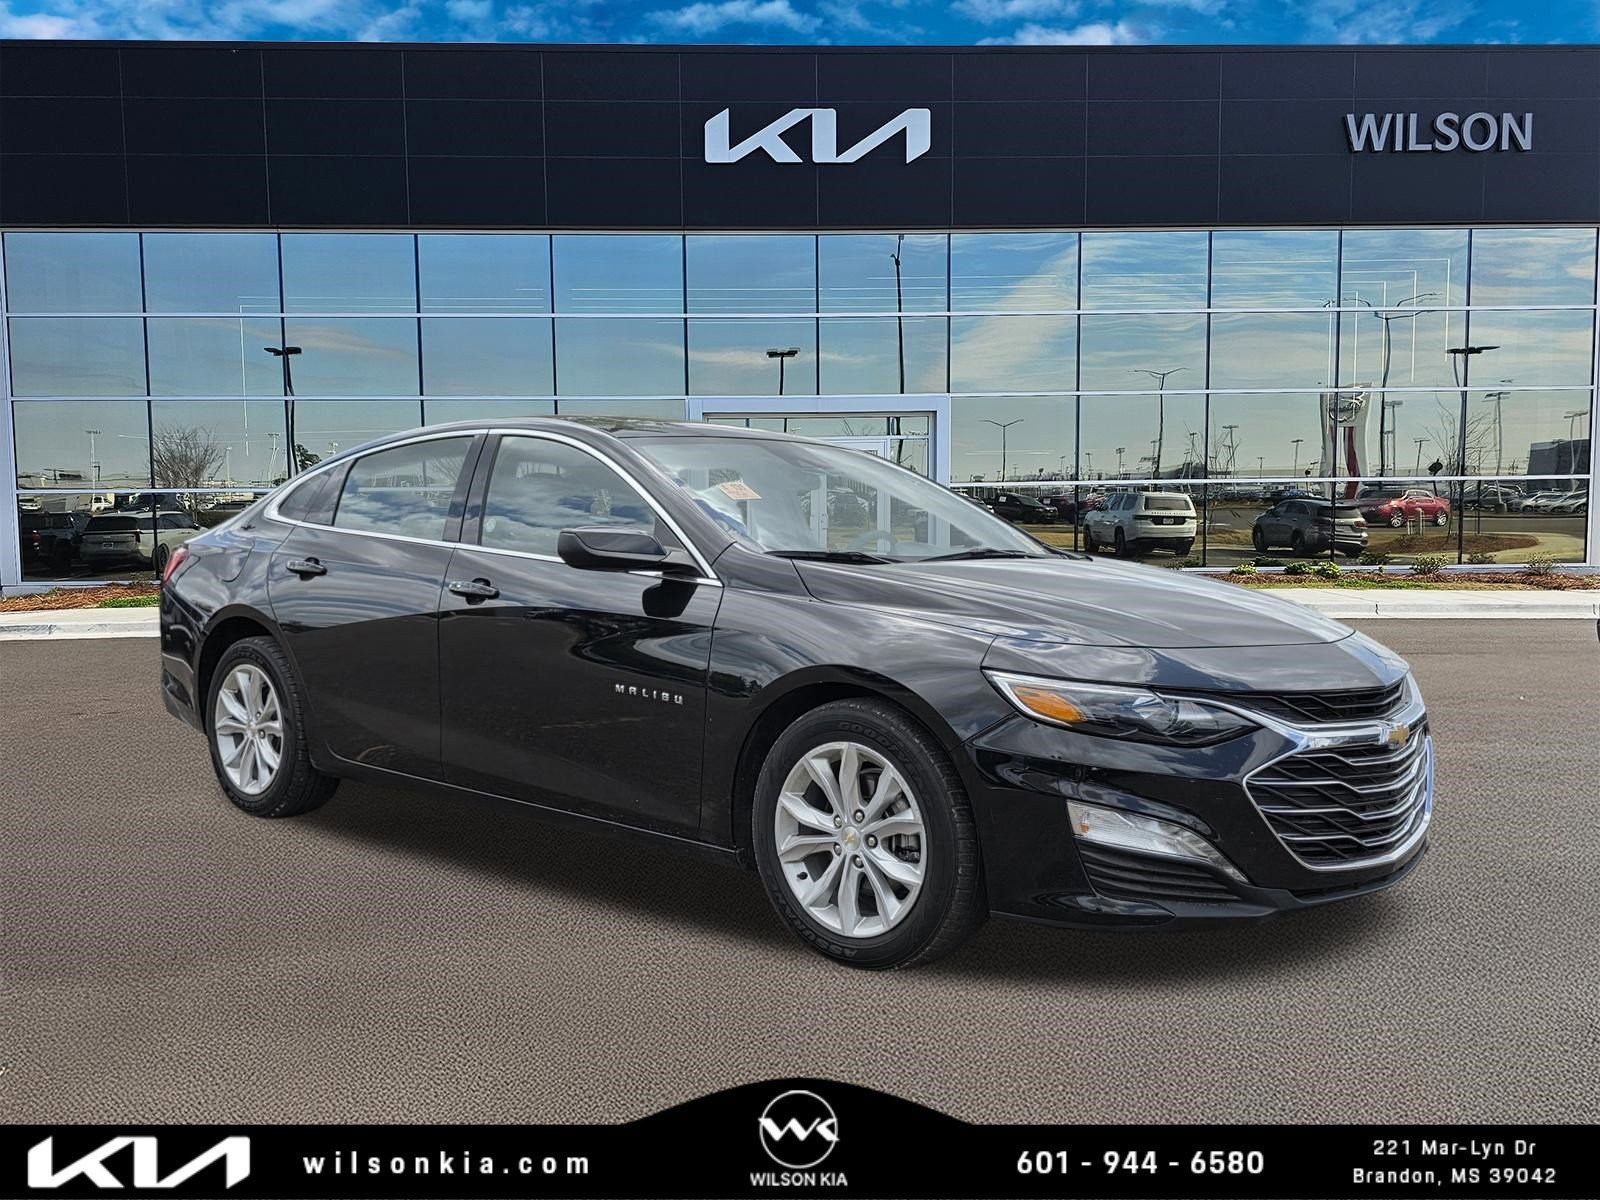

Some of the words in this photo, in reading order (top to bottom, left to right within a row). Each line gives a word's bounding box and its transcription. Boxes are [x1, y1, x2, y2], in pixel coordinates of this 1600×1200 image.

[705, 108, 931, 163] KIA
[1347, 112, 1532, 151] WILSON
[615, 684, 682, 704] MALIBU
